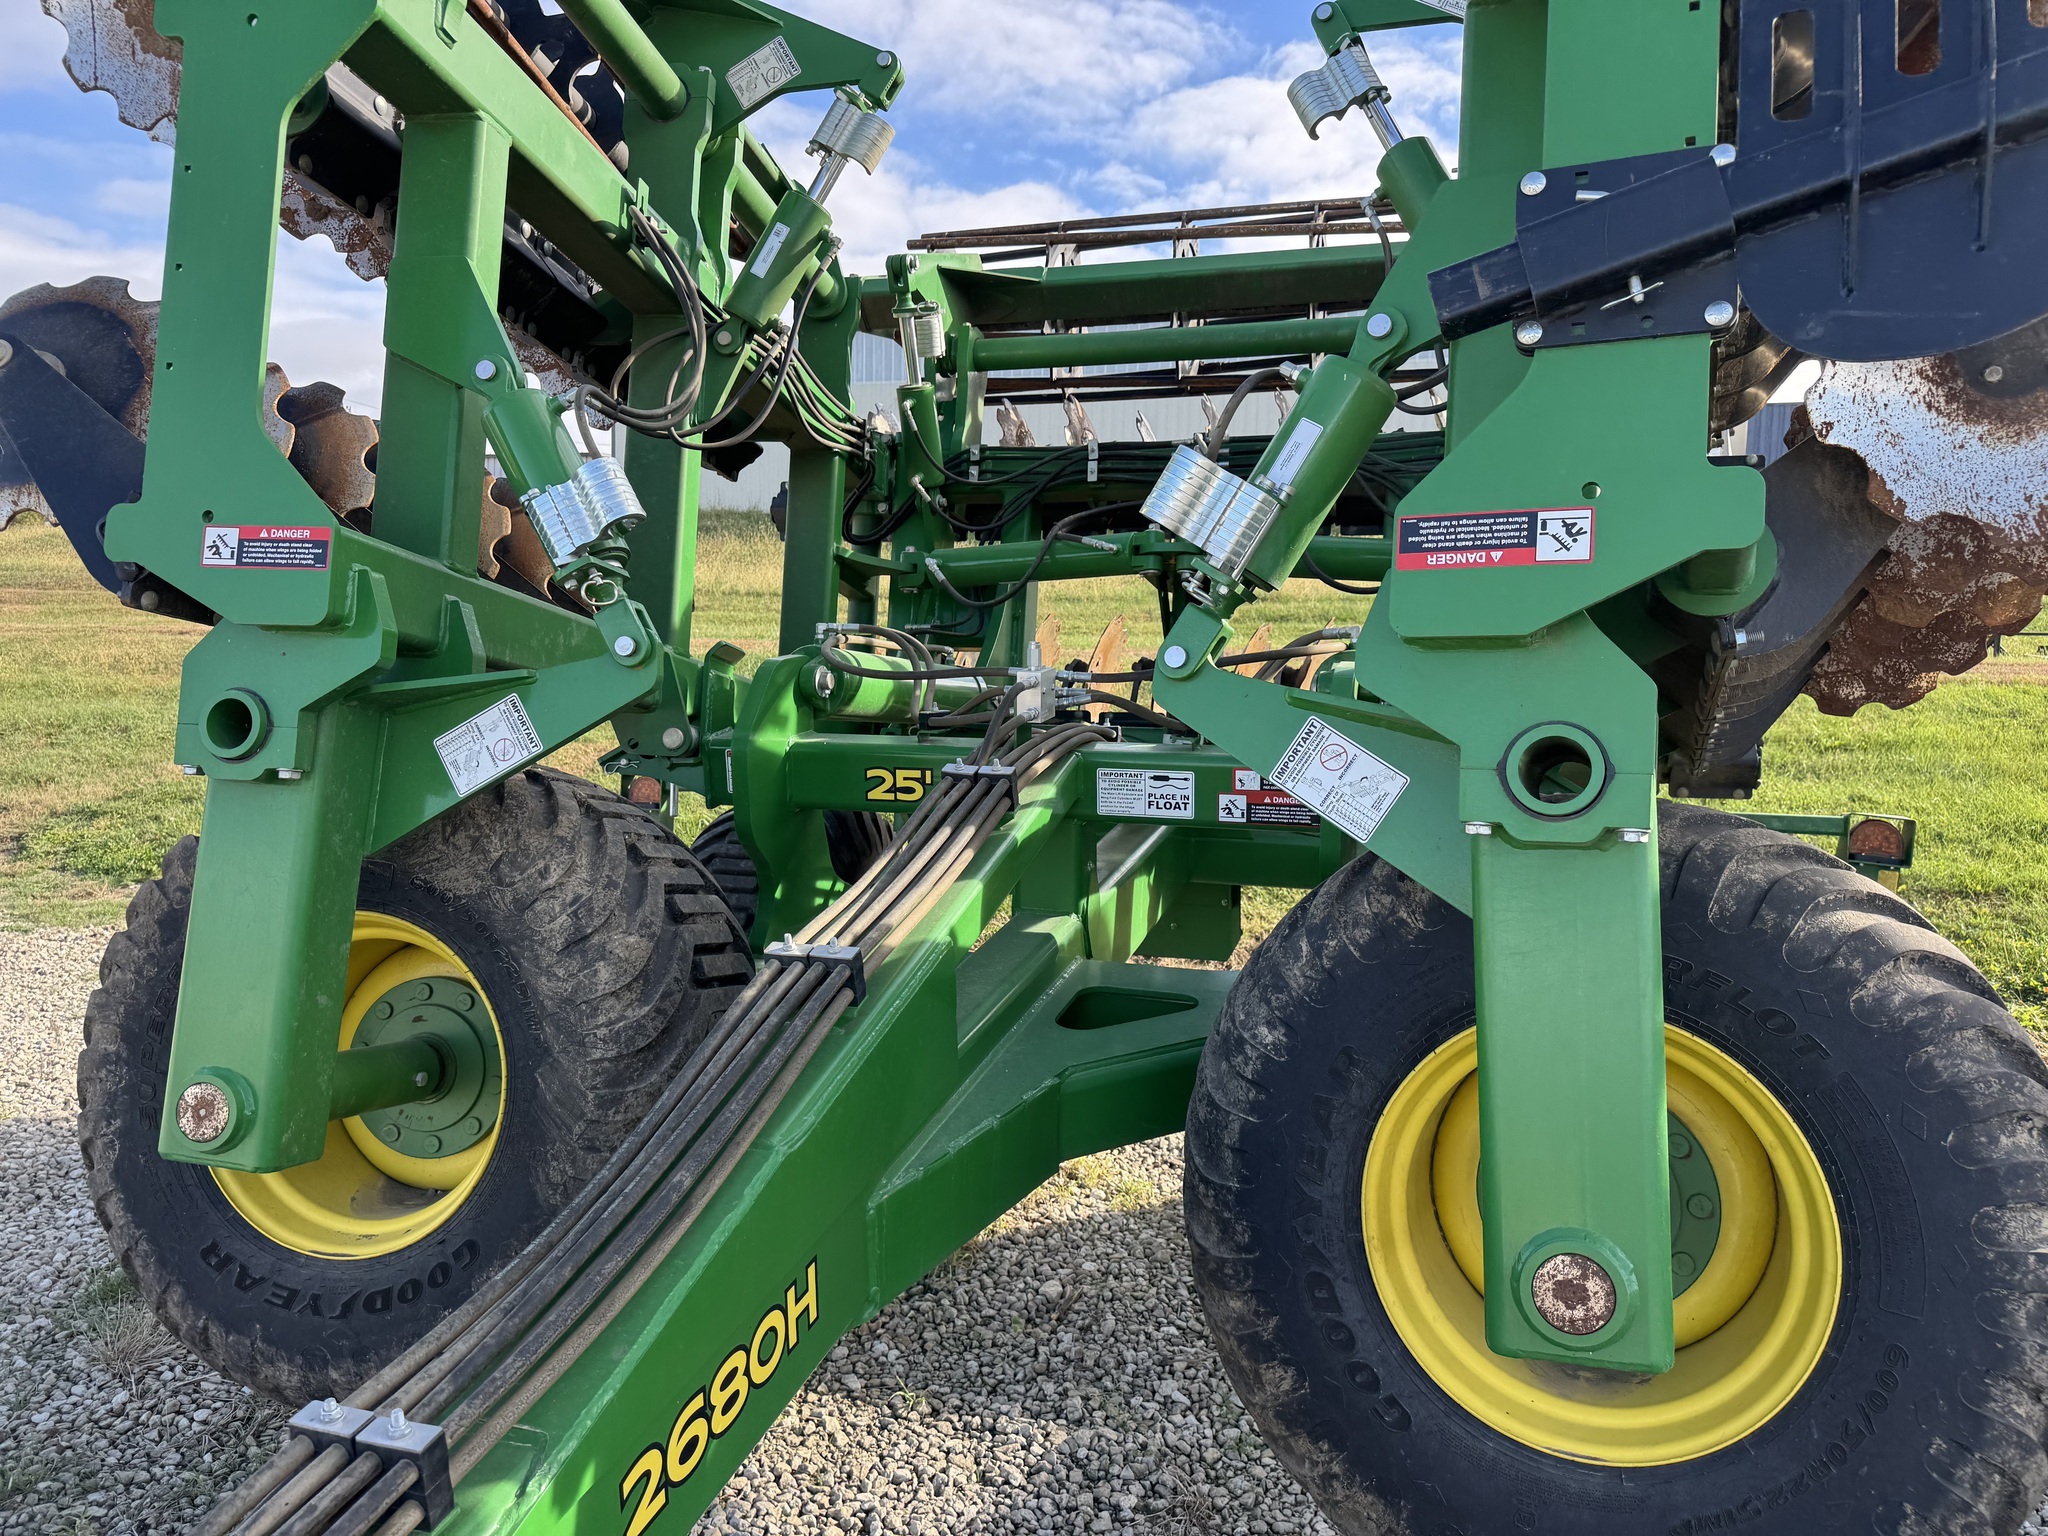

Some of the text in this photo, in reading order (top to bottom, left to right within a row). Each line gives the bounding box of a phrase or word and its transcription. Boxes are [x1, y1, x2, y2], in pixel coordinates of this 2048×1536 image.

[777, 40, 798, 72] IMPORTANT
[271, 529, 310, 538] DANGER
[1427, 552, 1486, 565] DANGER
[509, 699, 538, 748] IMPORTANT
[1275, 722, 1317, 780] IMPORTANT
[1288, 767, 1297, 780] AVOID
[1296, 747, 1311, 767] POSSIBLE
[1310, 726, 1325, 747] CYLINDER
[1295, 753, 1313, 776] EQUIPMENT
[1312, 735, 1325, 752] DAMAGE
[865, 766, 933, 802] 25'
[1320, 753, 1358, 807] CORRECT INCORRECT
[1148, 801, 1190, 811] FLOAT
[1294, 1044, 1413, 1433] GOODYEAR
[200, 1238, 480, 1320] GOODYEAR
[619, 1254, 819, 1536] 2680H
